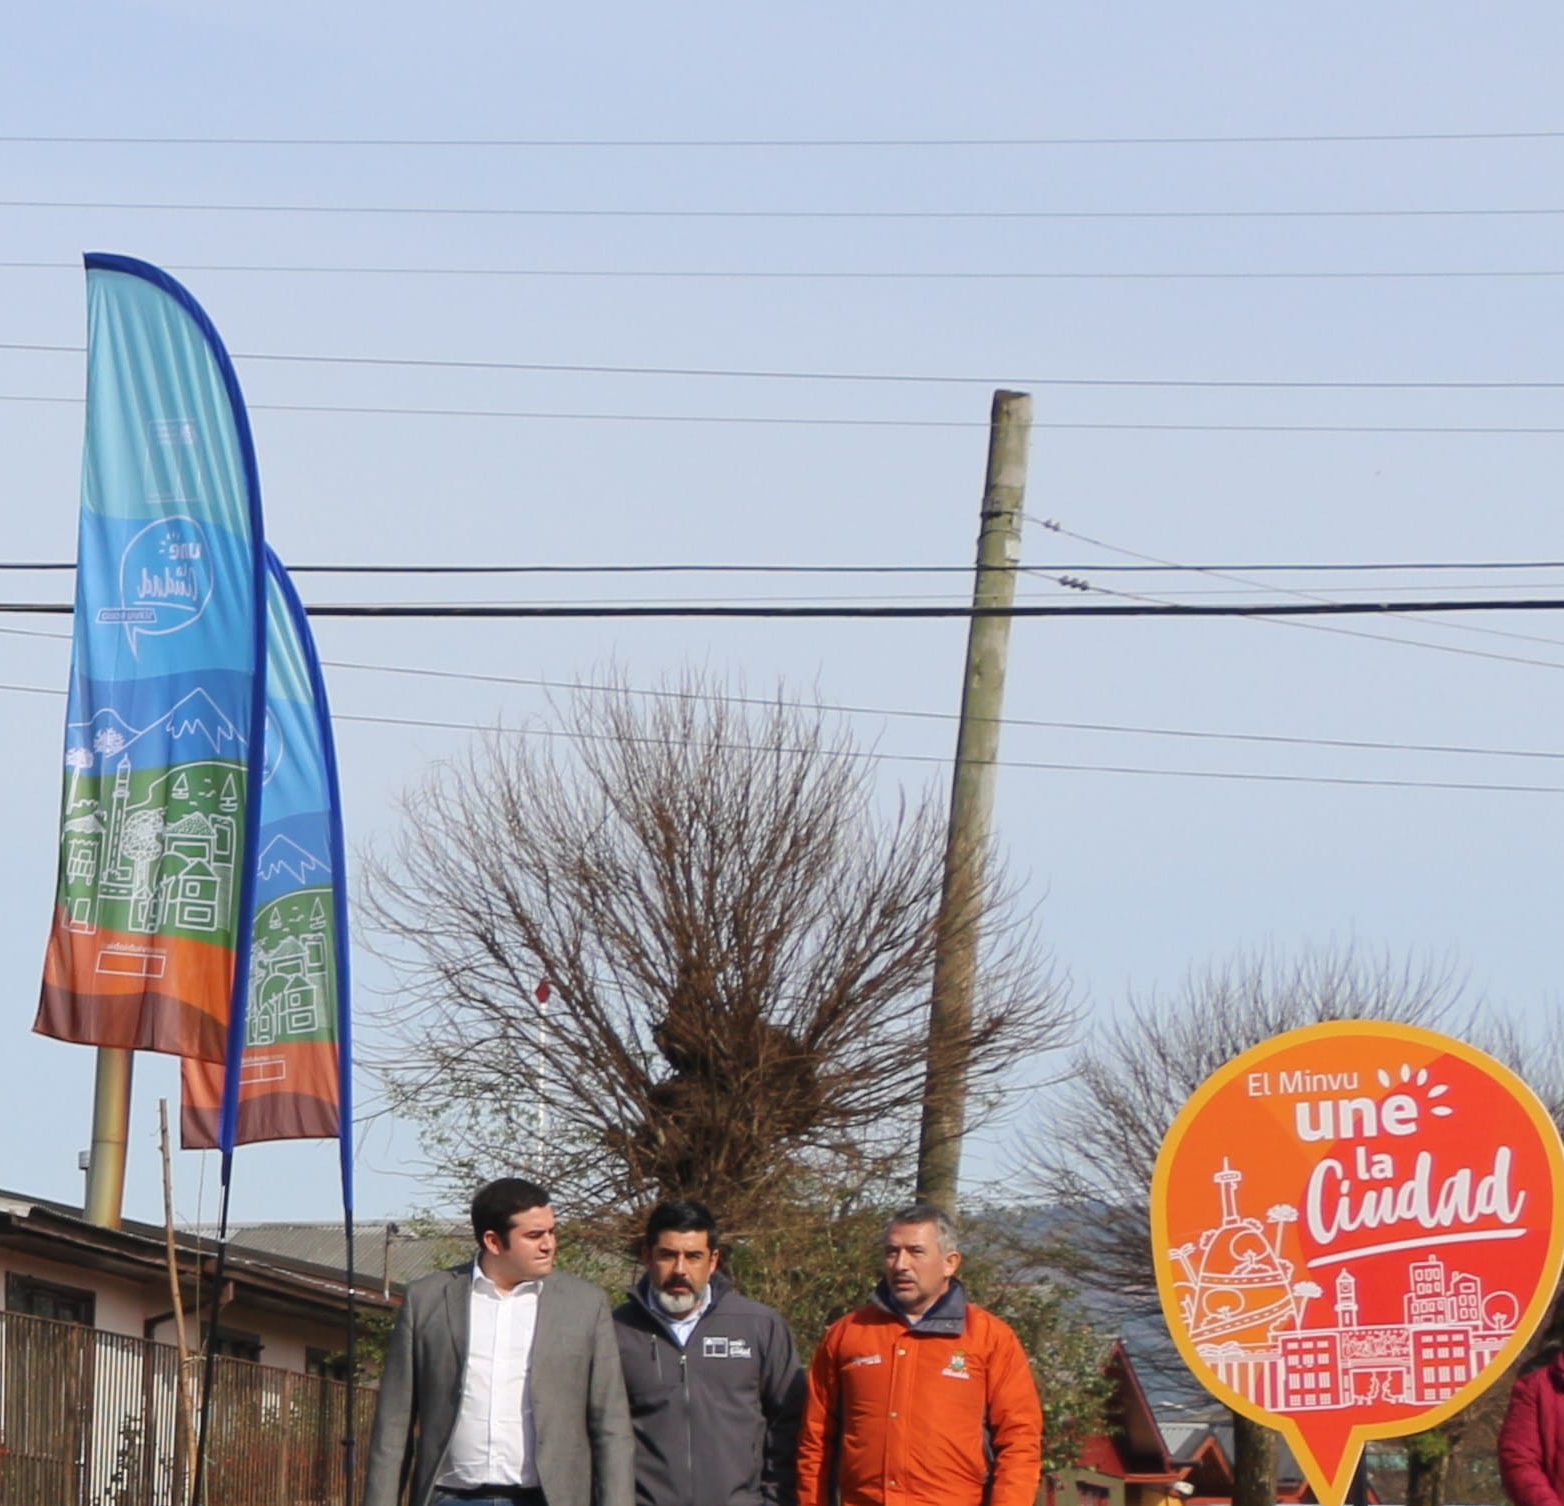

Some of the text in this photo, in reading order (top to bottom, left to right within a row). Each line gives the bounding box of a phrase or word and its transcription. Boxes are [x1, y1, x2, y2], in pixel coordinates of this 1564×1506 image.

[1248, 1069, 1359, 1097] El Minvu
[1295, 1094, 1418, 1142] une
[1356, 1146, 1394, 1180] la
[1307, 1145, 1527, 1245] Ciudad
